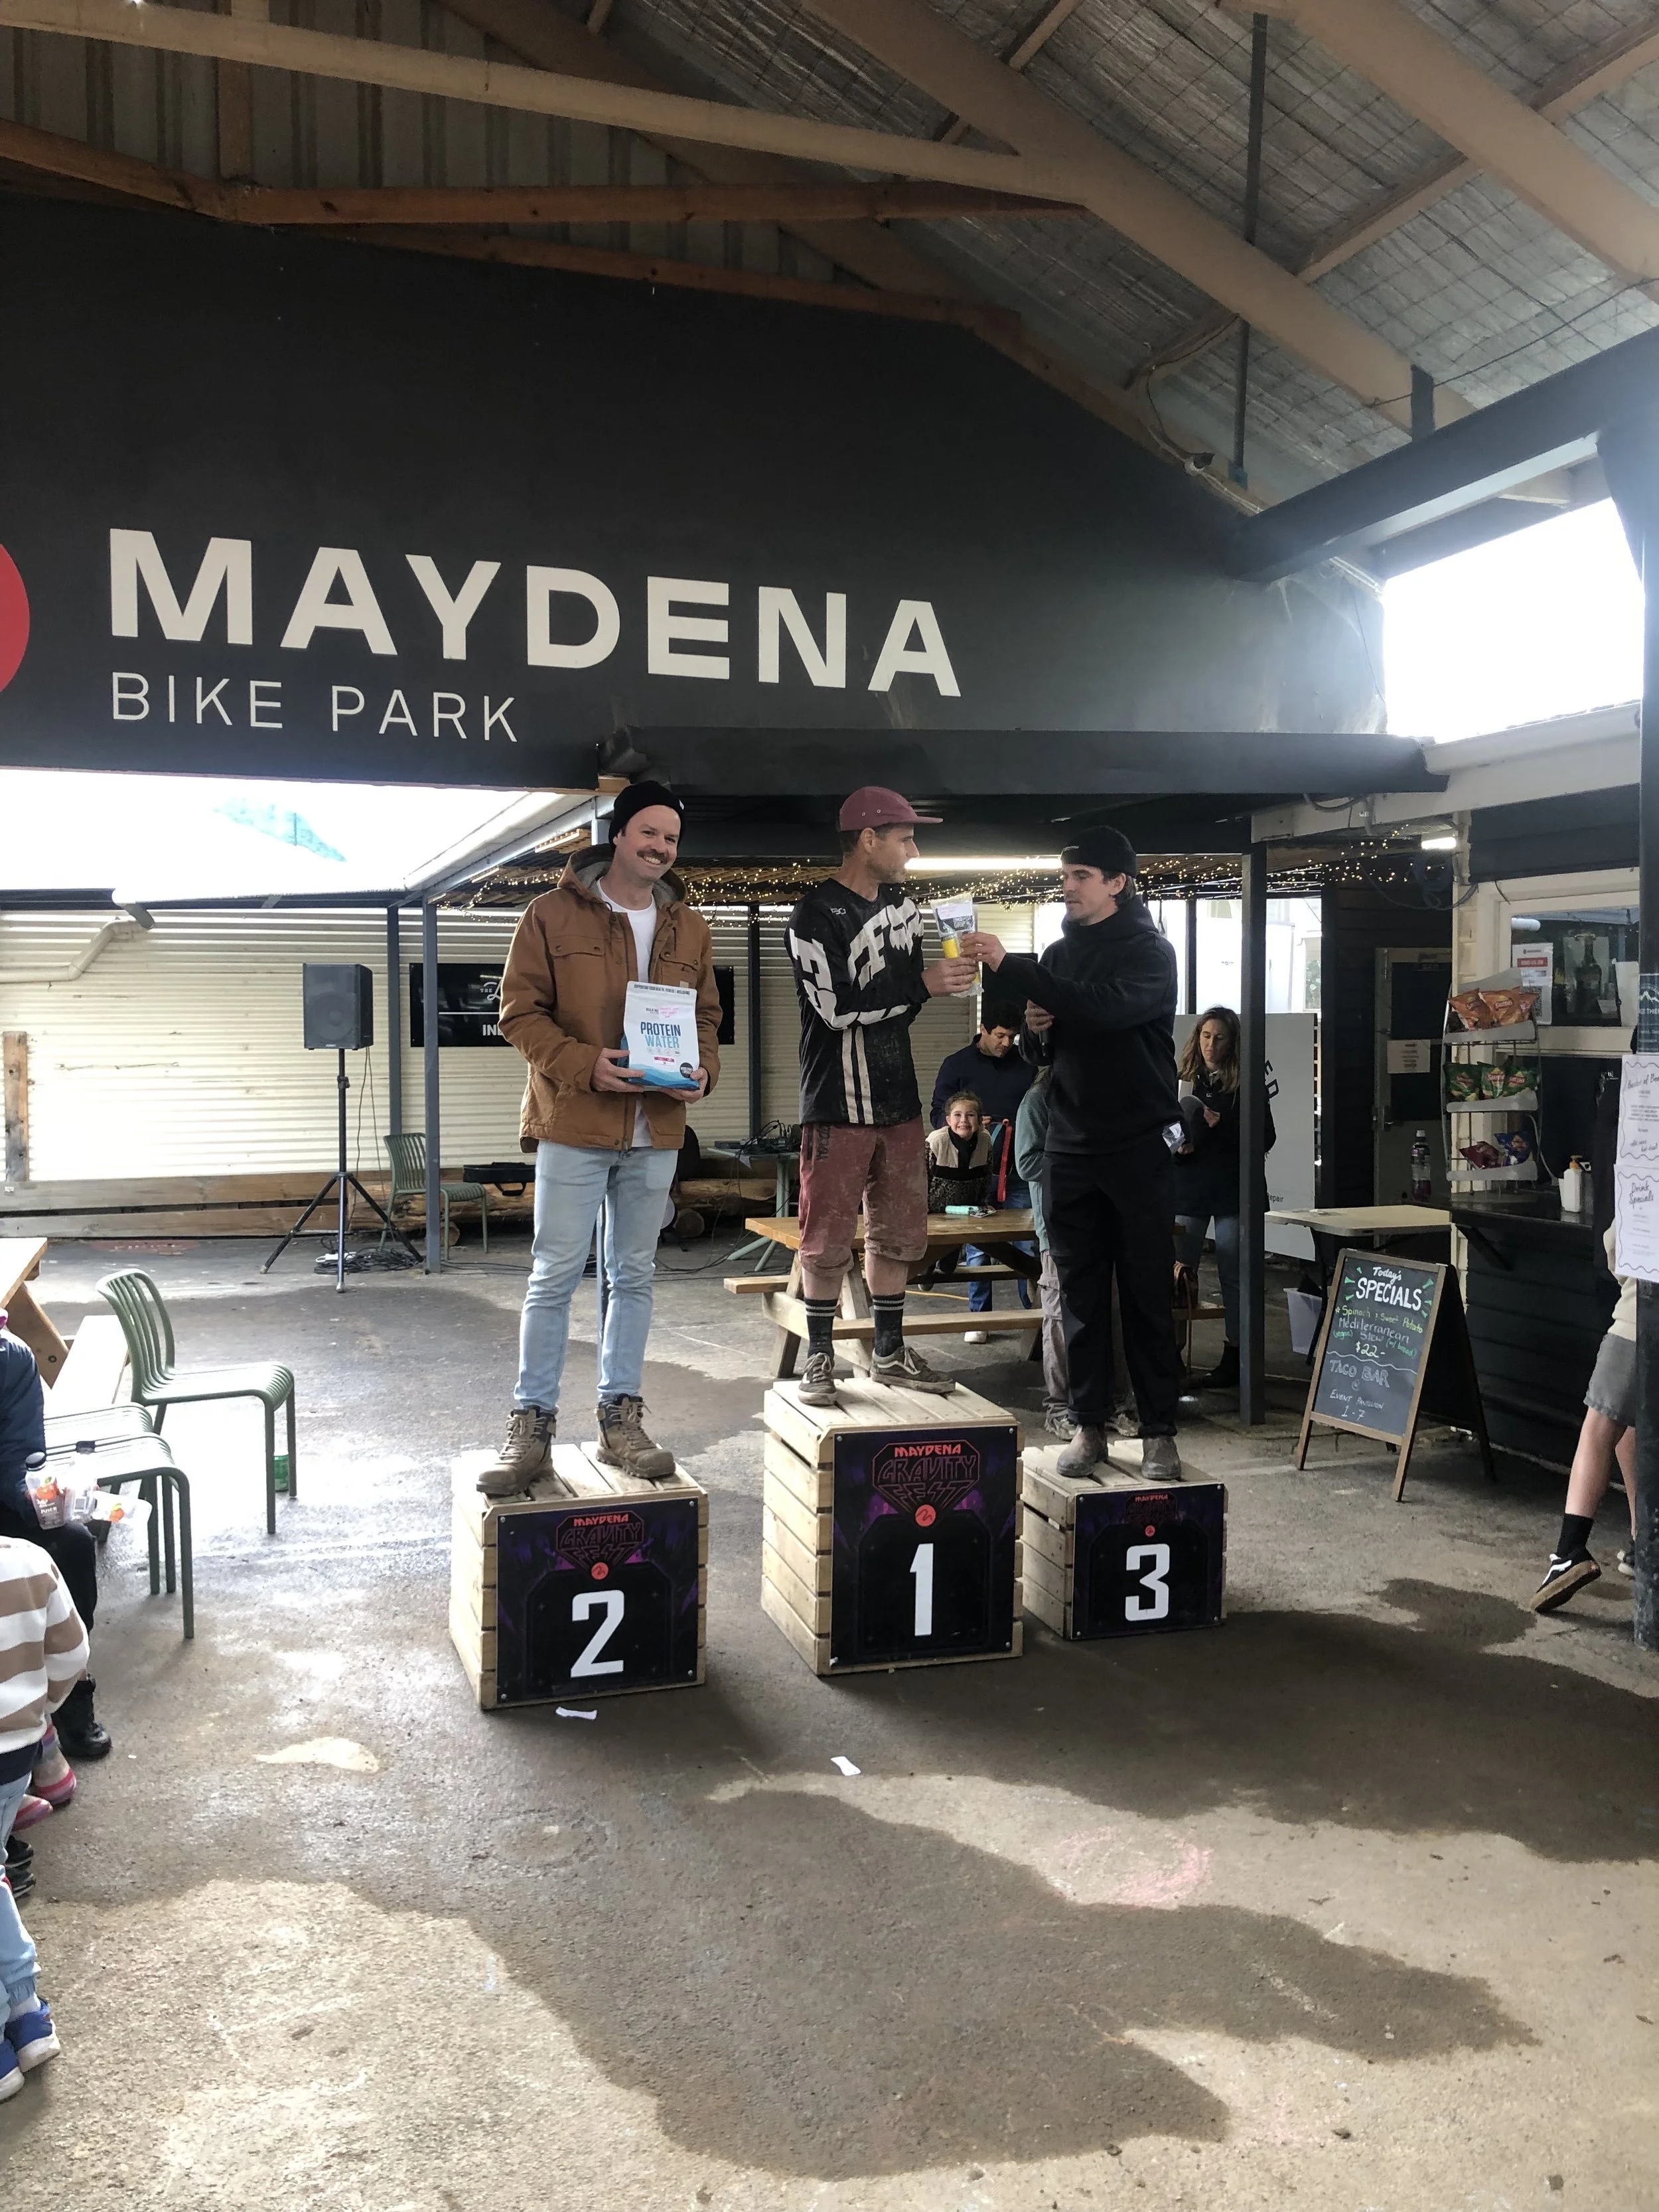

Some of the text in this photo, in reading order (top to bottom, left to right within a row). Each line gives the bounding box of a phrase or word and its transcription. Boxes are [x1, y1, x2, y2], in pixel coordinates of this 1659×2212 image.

[110, 528, 961, 698] MAYDENA
[112, 672, 518, 743] BIKE PARK
[640, 1021, 681, 1037] PROTEIN
[645, 1035, 680, 1049] WATER
[1631, 1181, 1650, 1194] Drink
[1629, 1190, 1654, 1210] Specials
[1372, 1266, 1402, 1284] Today's
[1355, 1277, 1422, 1311] SPECIALS
[1402, 1317, 1423, 1333] Potato
[1360, 1332, 1384, 1342] Stew
[1329, 1359, 1390, 1388] TACO BAR
[1330, 1389, 1353, 1402] EVENT
[895, 1443, 962, 1457] MAYDENA
[877, 1455, 977, 1484] GRAVITY
[1135, 1493, 1168, 1503] MAYDENA
[573, 1513, 629, 1527] MAYDENA
[559, 1522, 642, 1548] GRAVITY
[910, 1543, 934, 1636] 1
[1125, 1543, 1170, 1621] 3
[570, 1589, 625, 1678] 2
